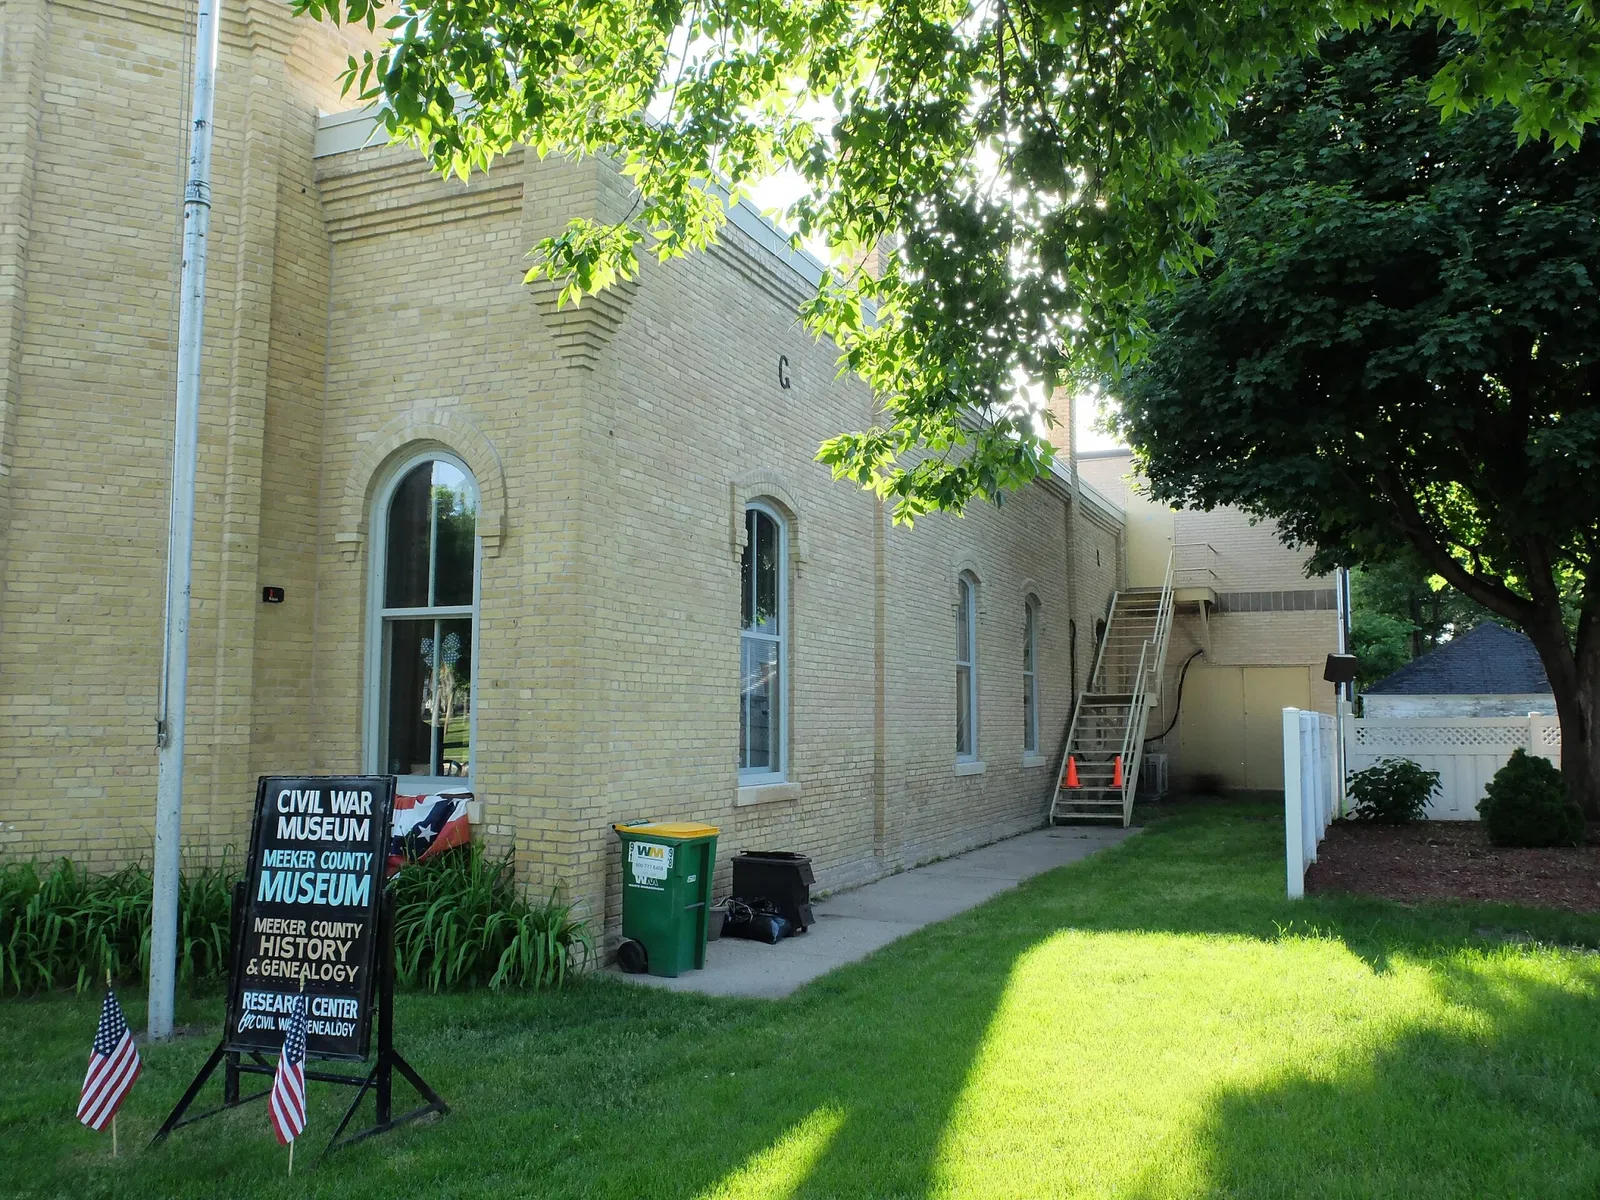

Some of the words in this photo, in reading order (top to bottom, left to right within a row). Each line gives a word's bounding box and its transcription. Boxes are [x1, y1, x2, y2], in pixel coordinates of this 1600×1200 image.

[277, 789, 324, 815] CIVIL
[330, 790, 373, 815] WAR
[276, 816, 370, 842] MUSEUM
[262, 849, 316, 868] MEEKER
[320, 851, 373, 872] COUNTY
[637, 845, 664, 858] WM
[257, 870, 371, 907] MUSEUM
[254, 917, 306, 936] MEEKER
[310, 920, 363, 939] COUNTY
[259, 935, 352, 962] HISTORY
[246, 958, 258, 975] &
[261, 959, 359, 983] GENEALOGY
[312, 997, 359, 1019] CENTER
[237, 1009, 257, 1033] for
[256, 1015, 276, 1030] CIVIL
[305, 1019, 356, 1037] ENEALOGY
